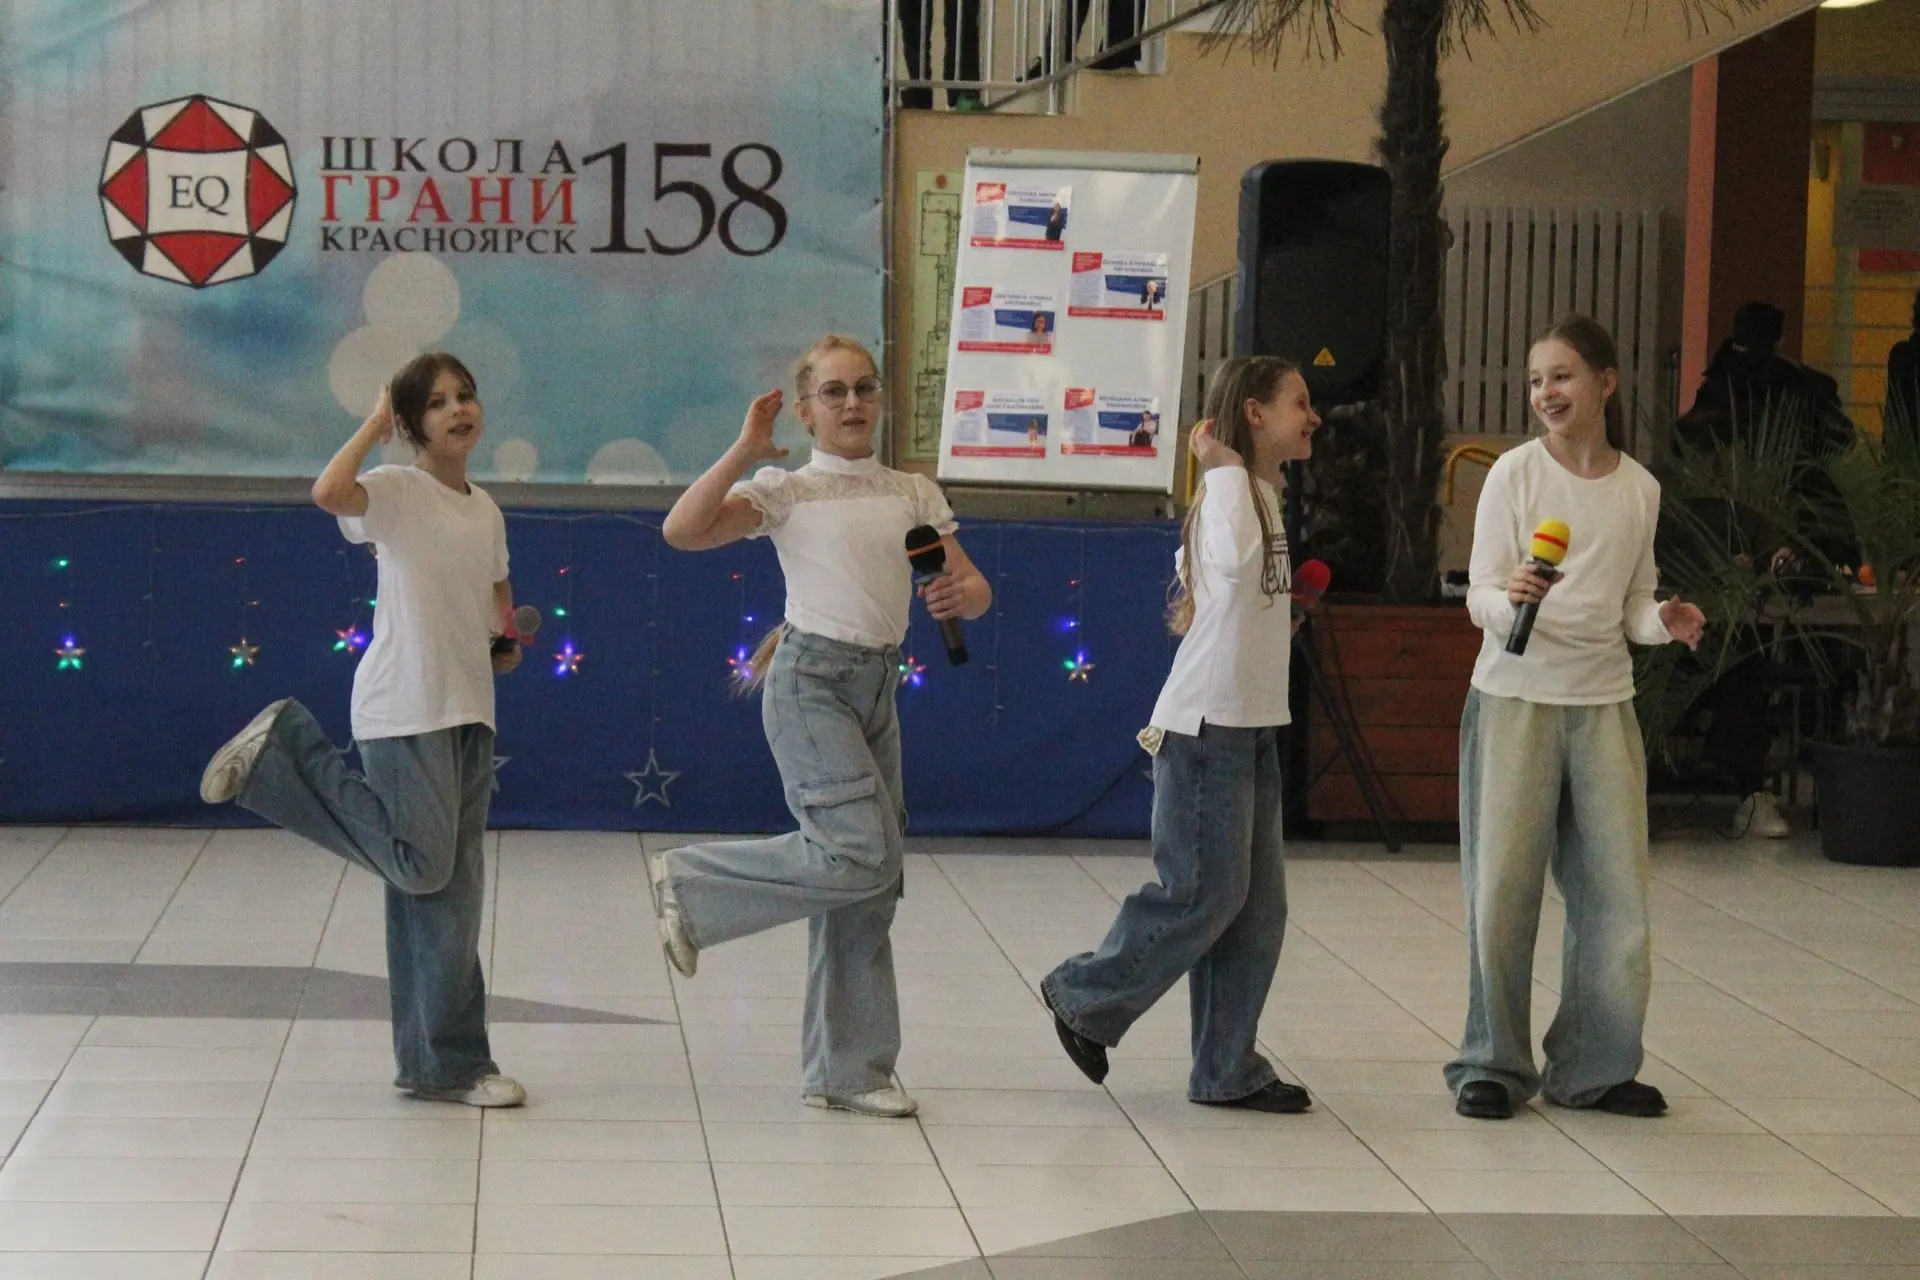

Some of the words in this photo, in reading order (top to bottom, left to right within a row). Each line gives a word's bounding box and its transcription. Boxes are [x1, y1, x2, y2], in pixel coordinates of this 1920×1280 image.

[321, 136, 577, 174] ШКОЛА
[168, 175, 231, 216] EQ
[321, 175, 577, 225] ГРАНИ
[581, 142, 788, 257] 158
[321, 226, 577, 254] КРАСНОЯРСК
